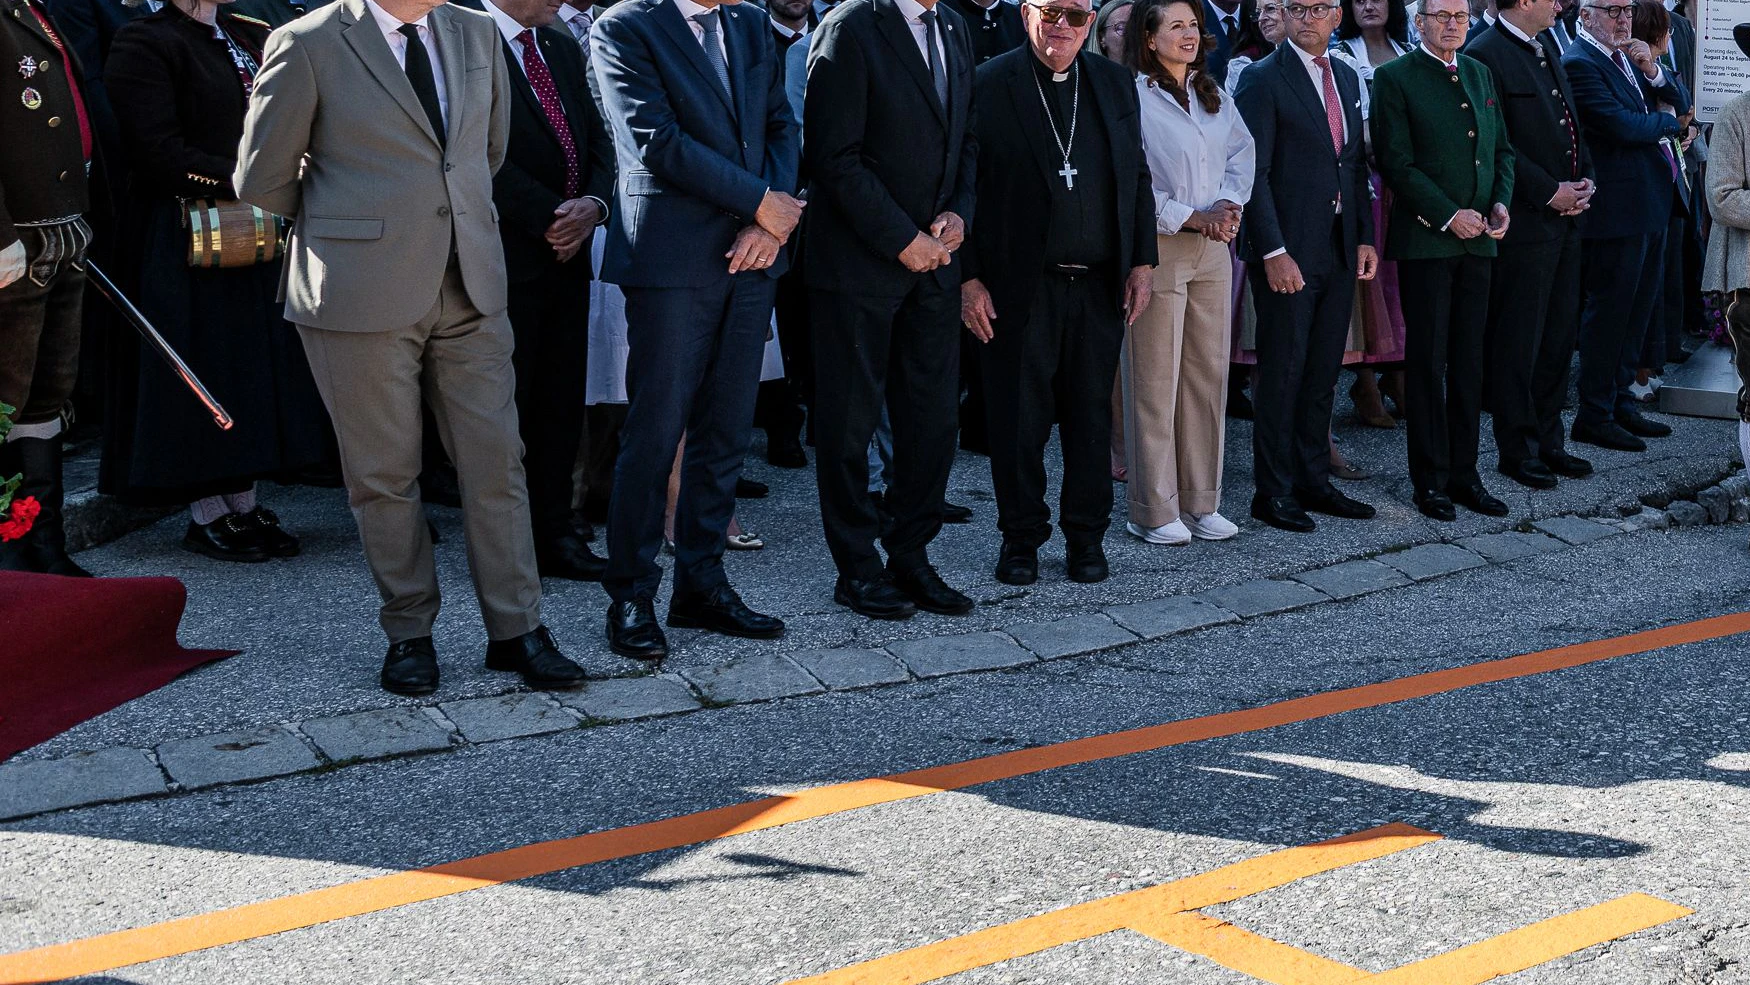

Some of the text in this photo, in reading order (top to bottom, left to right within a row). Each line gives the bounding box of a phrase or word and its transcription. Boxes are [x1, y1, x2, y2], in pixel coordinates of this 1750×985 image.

[1703, 47, 1726, 55] Operating
[1703, 64, 1725, 72] Operating
[1702, 86, 1716, 94] Every
